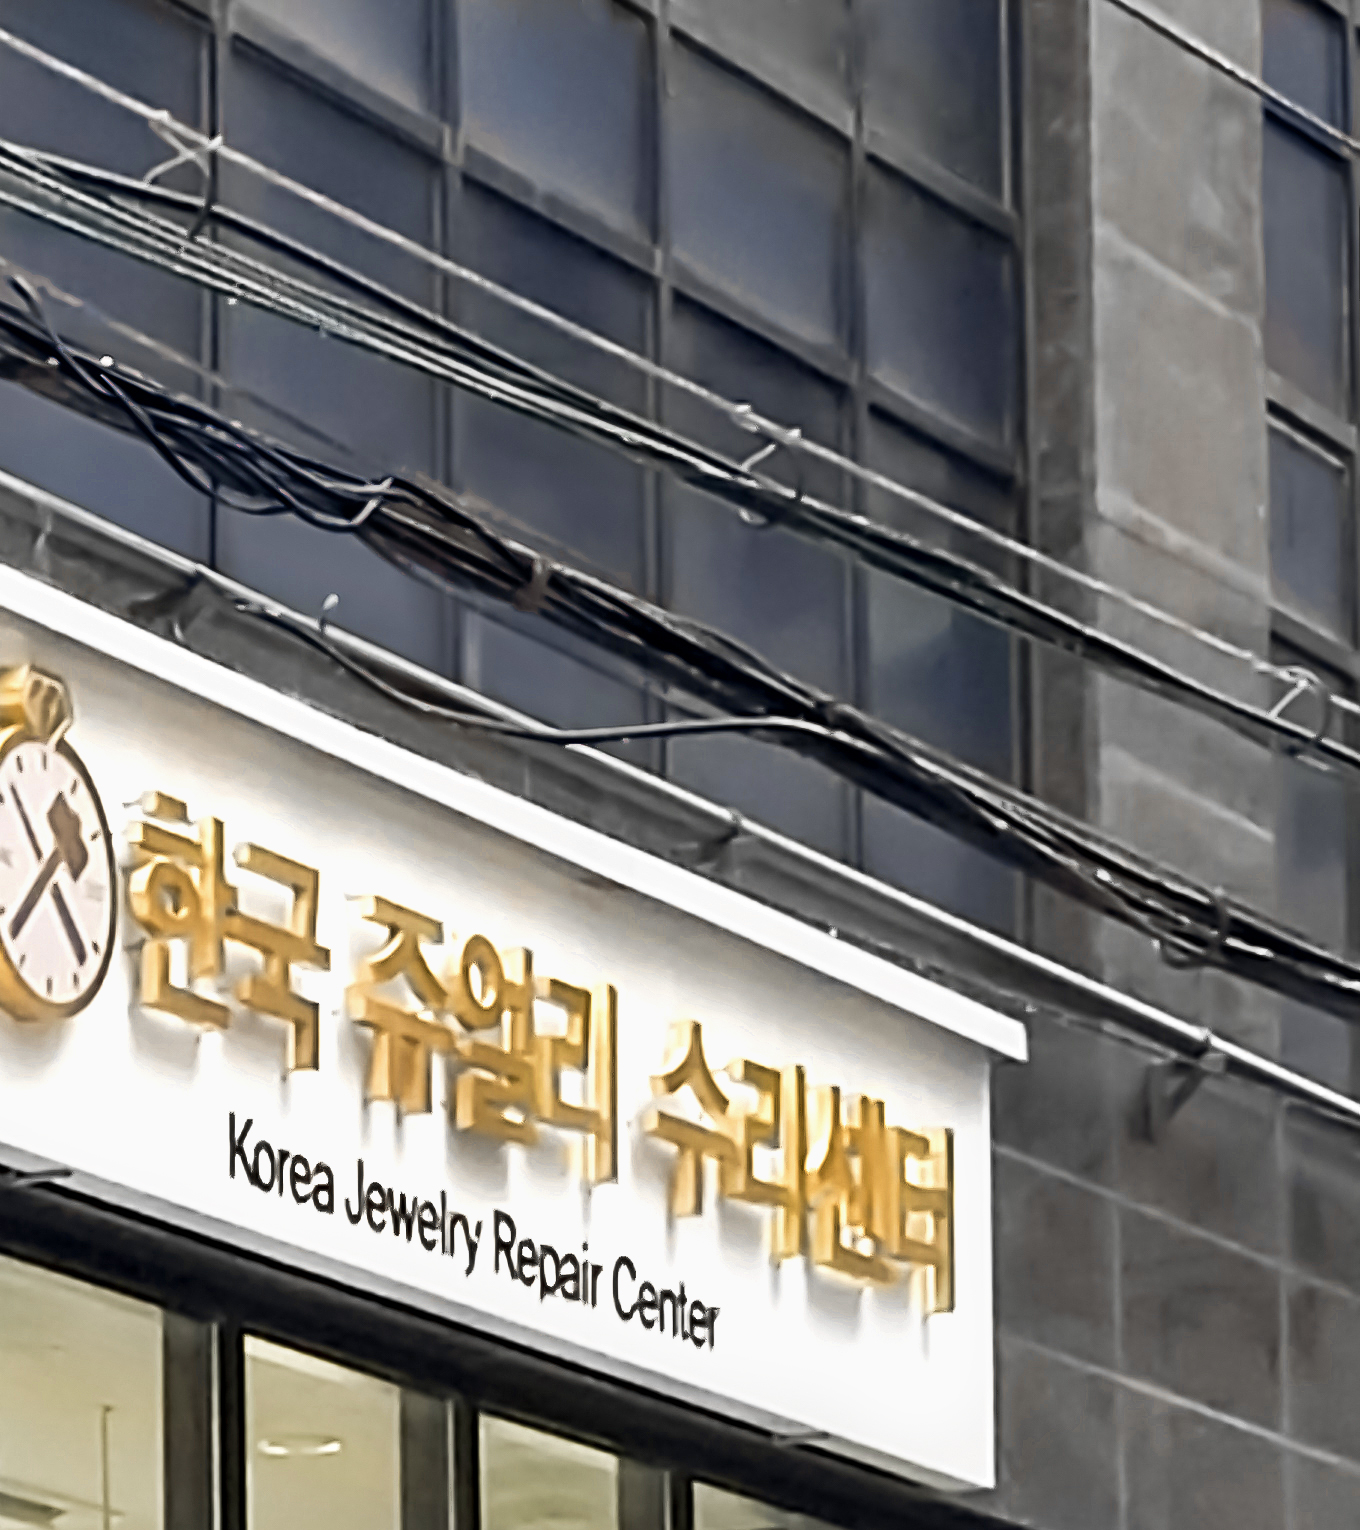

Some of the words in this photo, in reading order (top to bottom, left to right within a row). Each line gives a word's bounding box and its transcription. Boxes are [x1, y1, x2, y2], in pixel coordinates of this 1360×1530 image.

[126, 793, 330, 1070] 한국
[348, 896, 618, 1182] 쥬얼리
[645, 1022, 954, 1312] 수리센터
[230, 1113, 334, 1213] Korea
[346, 1159, 481, 1276] Jewelry
[494, 1210, 602, 1307] Repair
[613, 1256, 720, 1347] Center
